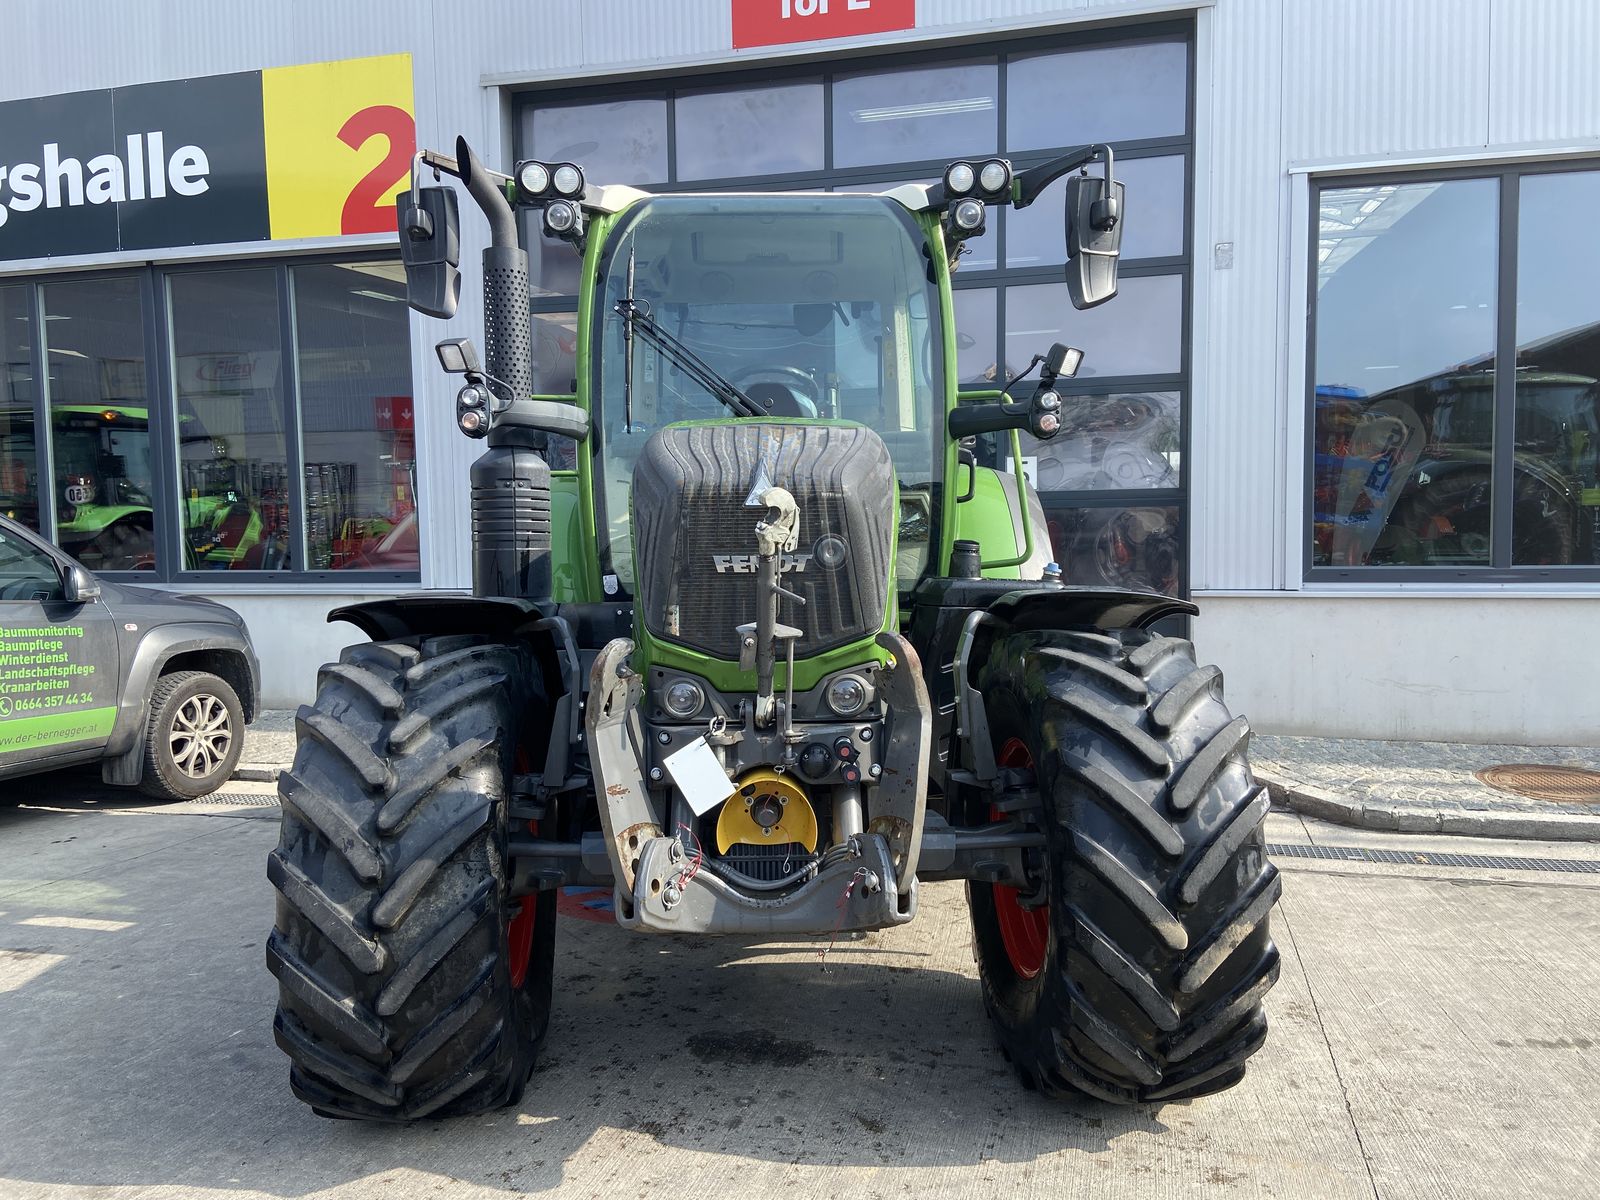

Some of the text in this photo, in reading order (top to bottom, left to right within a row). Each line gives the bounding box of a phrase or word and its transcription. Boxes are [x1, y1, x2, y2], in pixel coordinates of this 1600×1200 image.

[336, 105, 417, 236] 2
[0, 639, 63, 653] Baumpflege
[0, 652, 69, 666] Winterdienst
[0, 664, 95, 680] Landschaftspflege
[0, 679, 70, 694] Kranarbeiten
[15, 691, 93, 711] 0664 357 44 34
